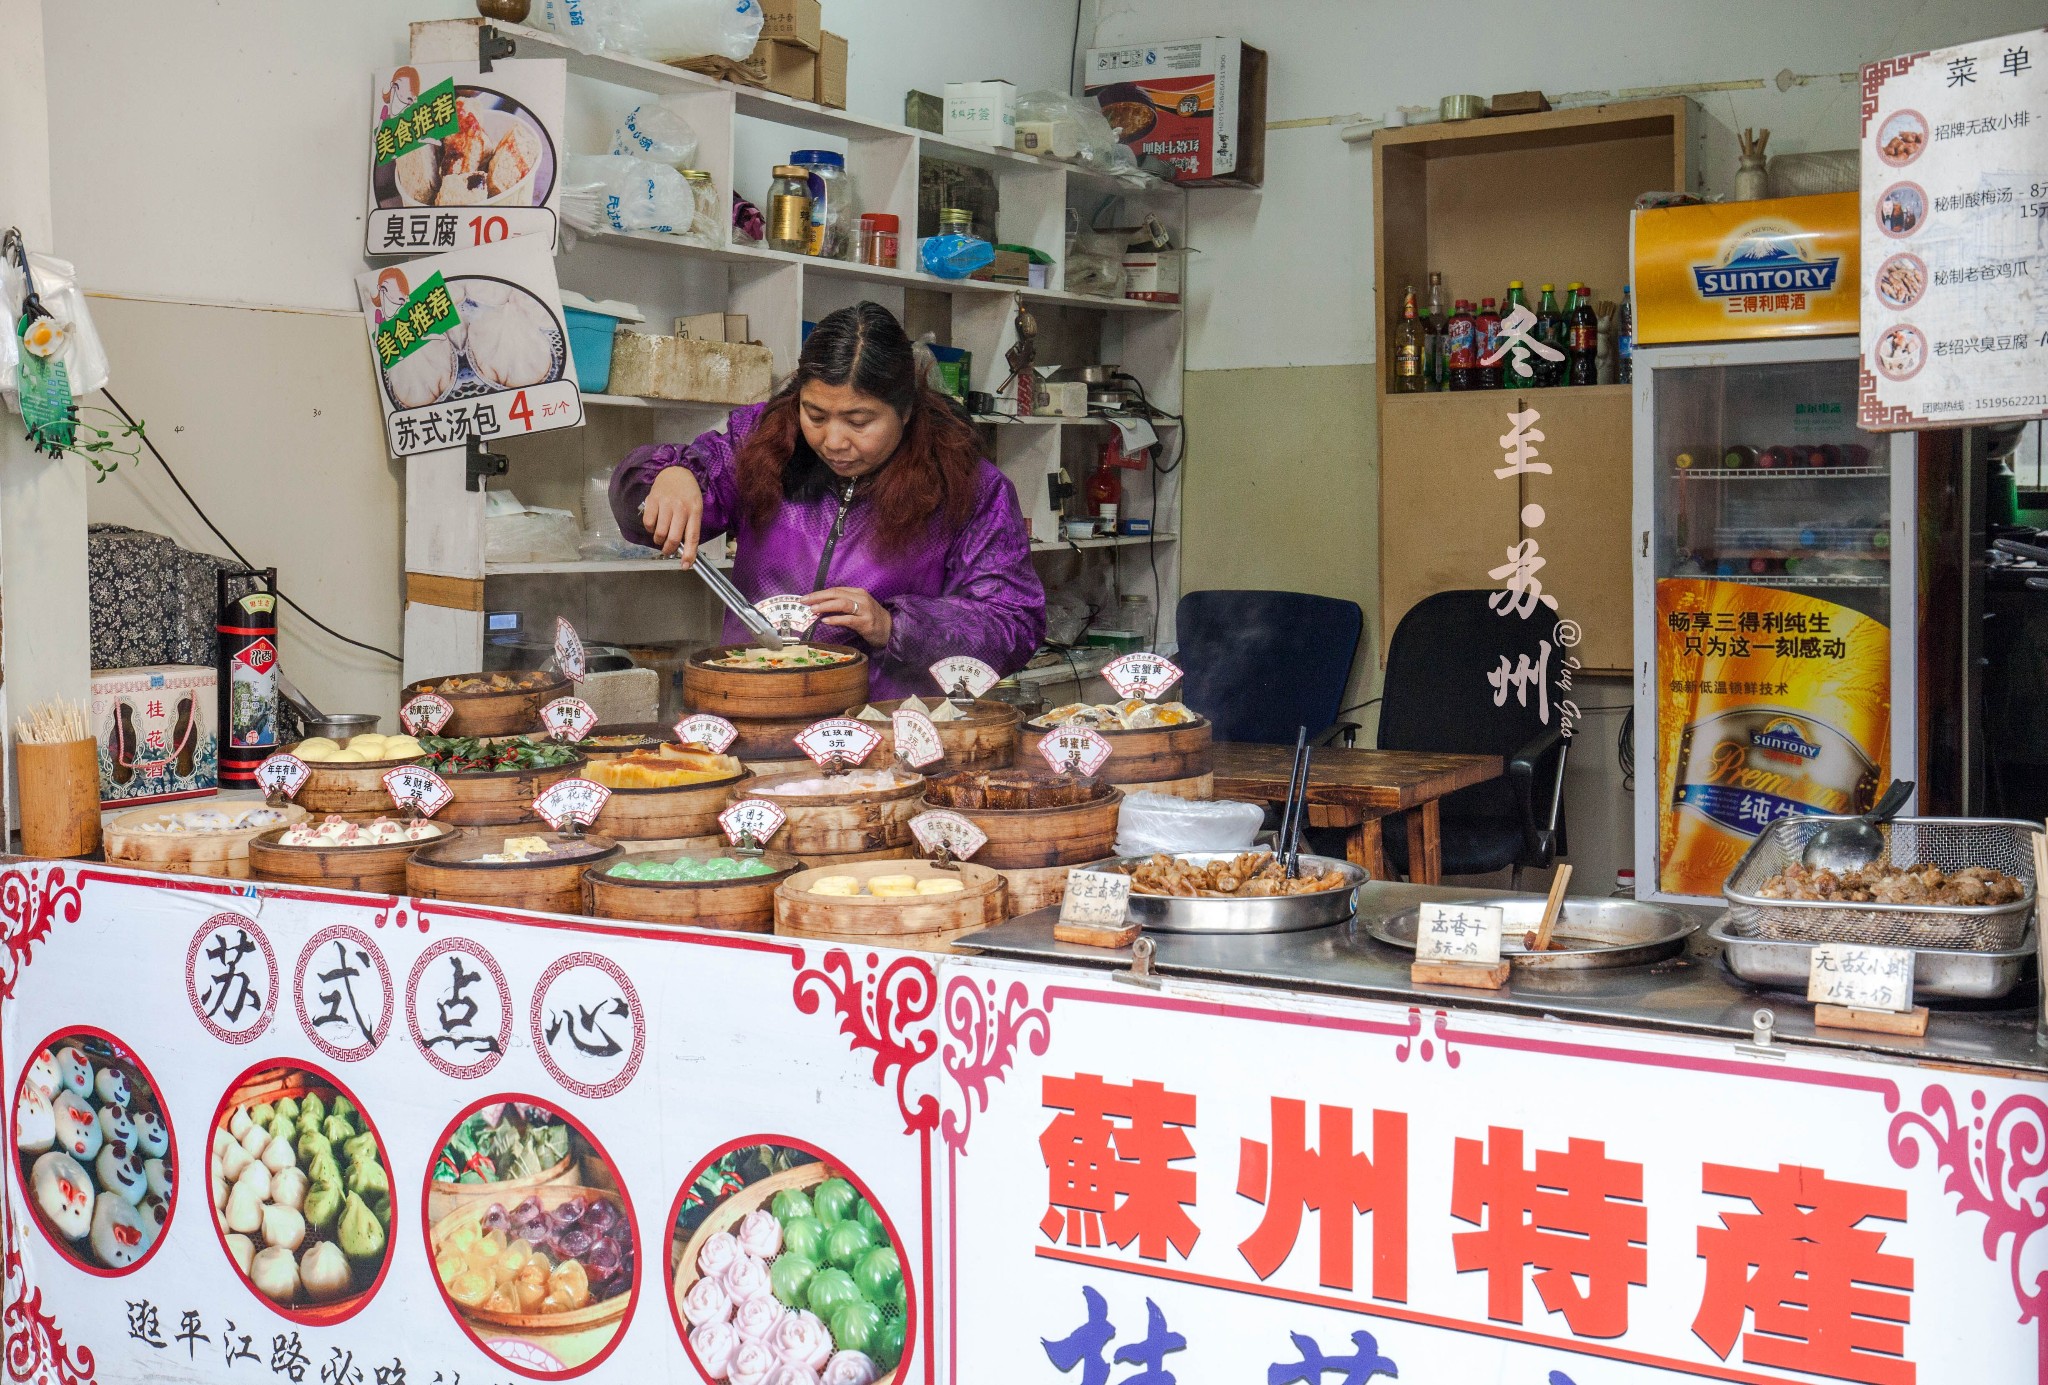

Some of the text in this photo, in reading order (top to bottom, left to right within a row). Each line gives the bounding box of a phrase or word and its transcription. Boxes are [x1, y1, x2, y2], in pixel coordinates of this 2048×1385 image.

[1946, 46, 2032, 88] 菜单
[376, 93, 456, 161] 美食推荐
[1934, 109, 2030, 142] 招牌无敌小排
[1142, 139, 1199, 155] 红烧牛肉面
[1934, 187, 2014, 213] 秘制酸梅汤
[383, 213, 509, 248] 臭豆腐 10
[1933, 260, 2029, 286] 秘制老爸鸡爪
[1728, 293, 1806, 314] 三得利啤酒
[376, 288, 452, 364] 美食推荐
[1932, 332, 2028, 357] 老绍兴臭豆腐
[394, 390, 570, 452] 苏式汤包 4 元/个
[1668, 611, 1831, 634] 畅享三得利纯生
[1683, 636, 1847, 660] 只为这一刻感动
[950, 664, 981, 678] 苏式汤包
[1119, 663, 1163, 675] 八宝蟹黄
[1133, 675, 1148, 684] 5元
[145, 699, 166, 778] 桂花酒
[829, 739, 846, 748] 3元
[1059, 737, 1090, 750] 蜂蜜糕
[1068, 750, 1081, 760] 3元
[267, 764, 297, 775] 年年有鱼
[276, 775, 287, 784] 2元
[403, 775, 433, 792] 发财猪
[410, 788, 423, 800] 2元
[1431, 909, 1487, 937] 卤香干
[1815, 950, 1908, 983] 无敌小排
[201, 929, 631, 1058] 苏式点心
[1827, 981, 1894, 1004] 15元一份
[1038, 1071, 1918, 1385] 蘇州特產
